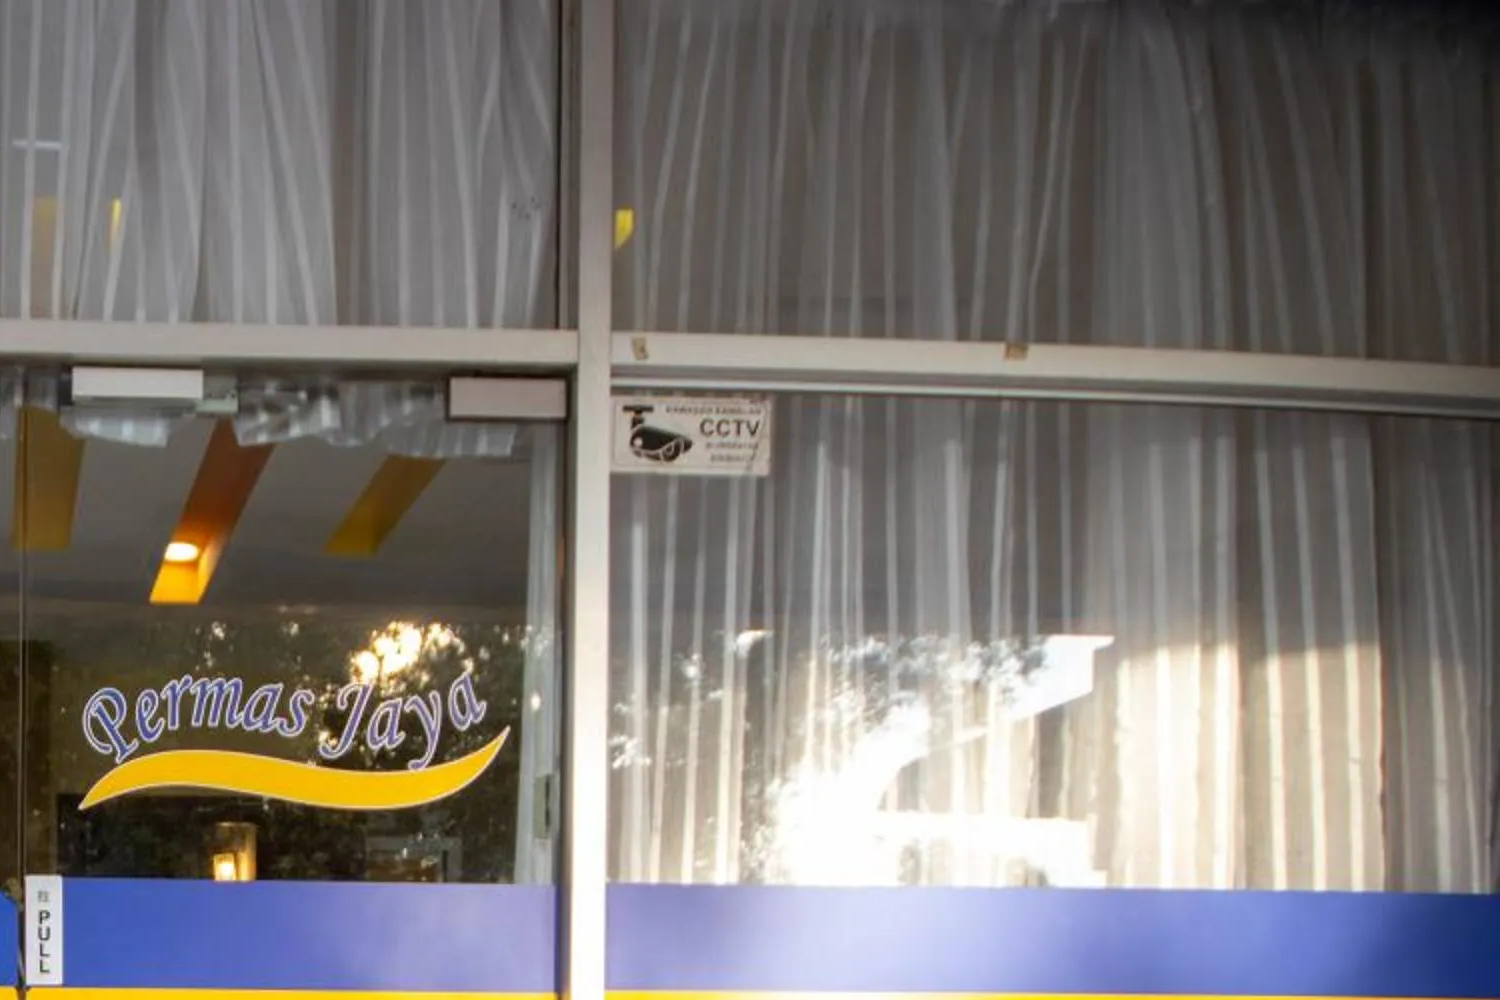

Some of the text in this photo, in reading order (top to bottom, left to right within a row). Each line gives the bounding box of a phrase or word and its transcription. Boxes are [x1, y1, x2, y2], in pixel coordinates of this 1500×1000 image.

[699, 418, 760, 437] CCTV
[81, 670, 487, 771] Permas Jaya
[38, 909, 51, 974] PULL
